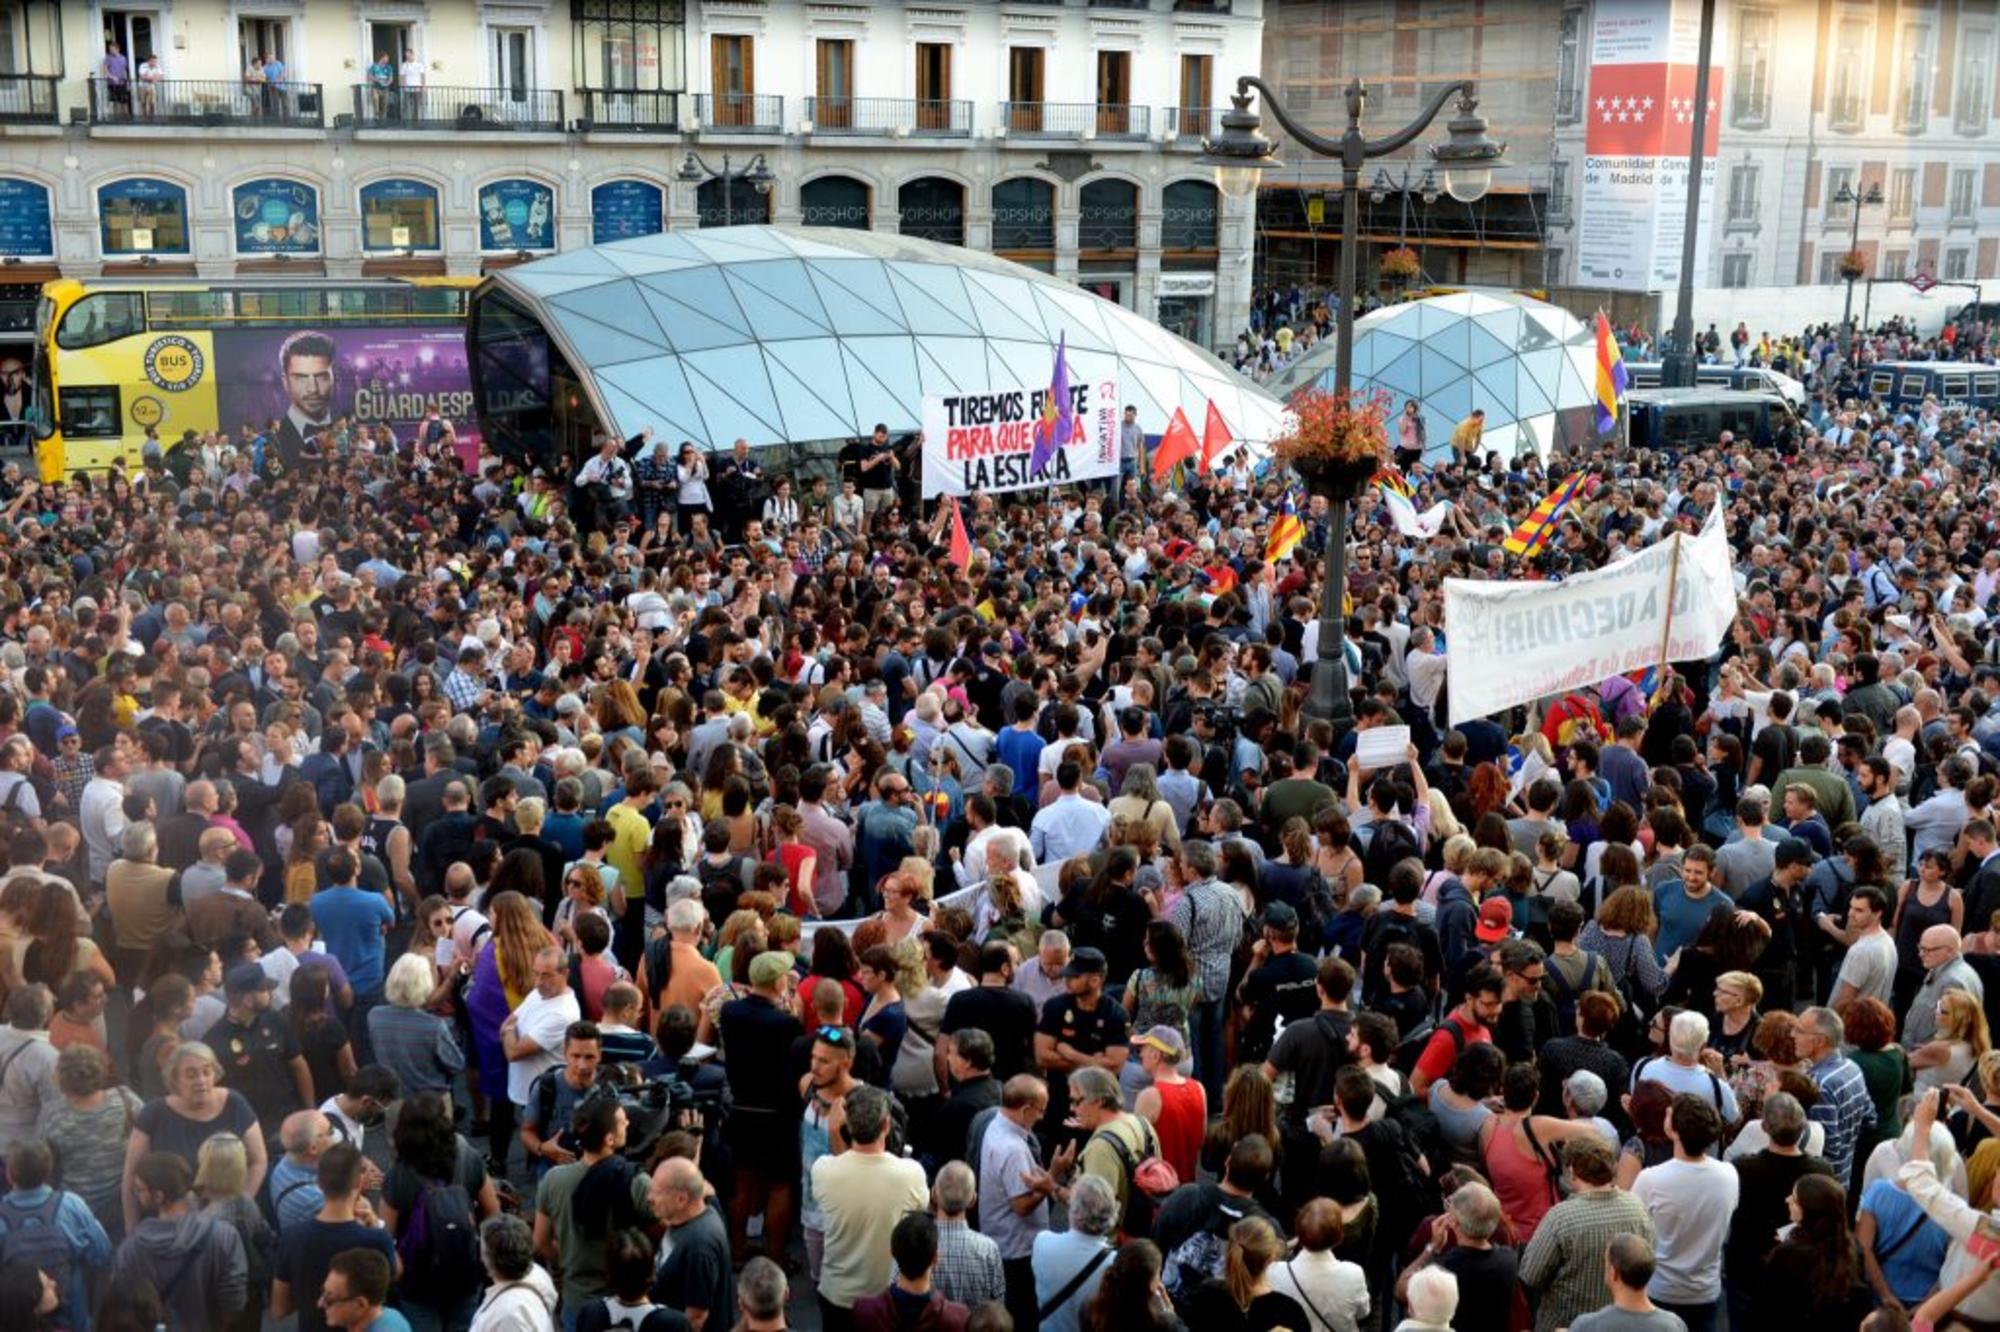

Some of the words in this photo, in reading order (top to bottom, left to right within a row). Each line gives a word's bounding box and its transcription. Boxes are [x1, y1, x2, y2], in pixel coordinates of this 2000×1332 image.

[1585, 158, 1655, 169] Comunidad
[1585, 173, 1600, 184] de
[1610, 173, 1653, 184] Madrid
[1163, 280, 1212, 290] TOPSHOP
[160, 355, 187, 366] BUS
[943, 391, 1024, 426] TIREMOS
[947, 426, 995, 460] PARA
[997, 422, 1032, 451] QUE
[964, 458, 990, 490] LA
